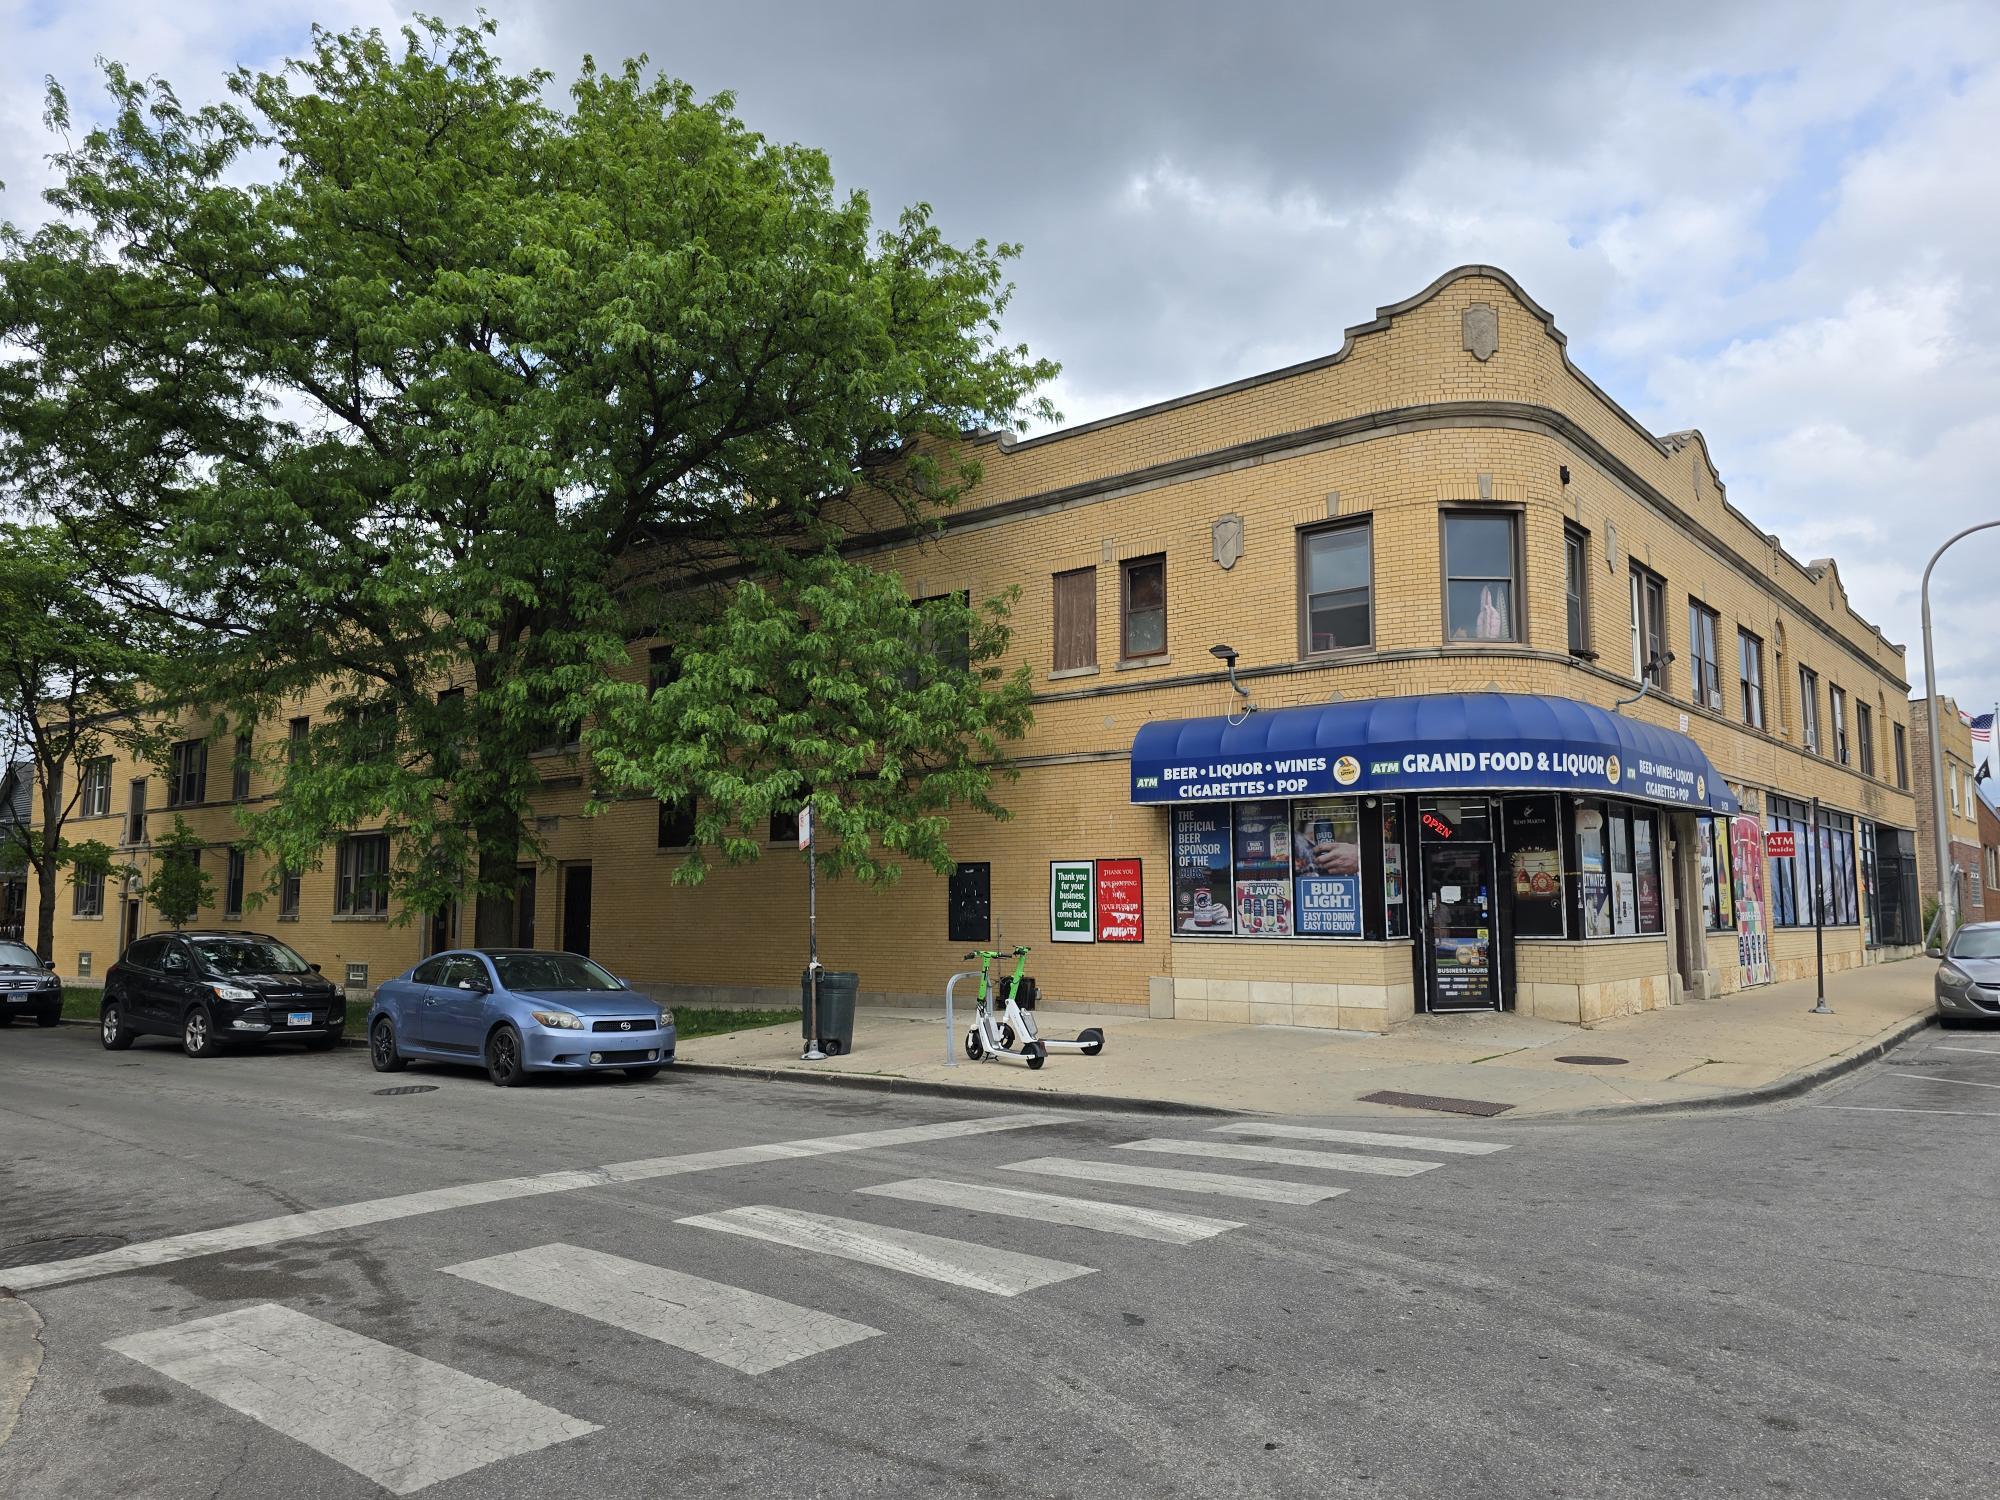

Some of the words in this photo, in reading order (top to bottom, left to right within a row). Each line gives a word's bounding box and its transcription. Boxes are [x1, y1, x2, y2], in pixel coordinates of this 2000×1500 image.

[1163, 766, 1198, 781] BEER
[1208, 762, 1263, 779] LIQUOR
[1274, 757, 1327, 774] WINES
[1372, 761, 1399, 774] ATM
[1402, 752, 1476, 773] GRAND
[1479, 751, 1534, 772] FOOD
[1537, 752, 1550, 772] &
[1553, 752, 1605, 777] LIQUOR
[1639, 759, 1653, 775] BEER
[1655, 763, 1673, 780] WINES
[1675, 768, 1694, 785] LIQUOR
[1136, 778, 1158, 788] ATM
[1179, 780, 1265, 798] CIGARETTES
[1276, 778, 1308, 793] POP
[1645, 781, 1676, 799] CIGARETTES
[1679, 787, 1689, 801] POP
[1178, 810, 1195, 820] THE
[1178, 821, 1216, 833] OFFICIAL
[1422, 812, 1453, 839] OPEN
[1178, 833, 1200, 844] BEER
[1316, 832, 1333, 840] BUD
[1768, 836, 1794, 846] ATM
[1178, 843, 1221, 855] SPONSOR
[1179, 856, 1191, 867] OF
[1192, 855, 1209, 867] THE
[1058, 872, 1075, 881] Thank
[1075, 874, 1087, 882] you
[1061, 881, 1070, 890] for
[1070, 883, 1085, 892] your
[1243, 886, 1284, 896] FLAVOR
[1310, 882, 1345, 896] BUD
[1059, 890, 1086, 900] business,
[1062, 900, 1082, 910] please
[1304, 895, 1352, 909] LIGHT
[1073, 910, 1088, 919] back
[1303, 912, 1321, 922] EASY
[1322, 912, 1333, 922] TO
[1333, 911, 1356, 922] DRINK
[1064, 919, 1080, 928] soon!
[1303, 921, 1321, 931] EASY
[1322, 921, 1333, 931] TO
[1333, 921, 1356, 931] ENJOY
